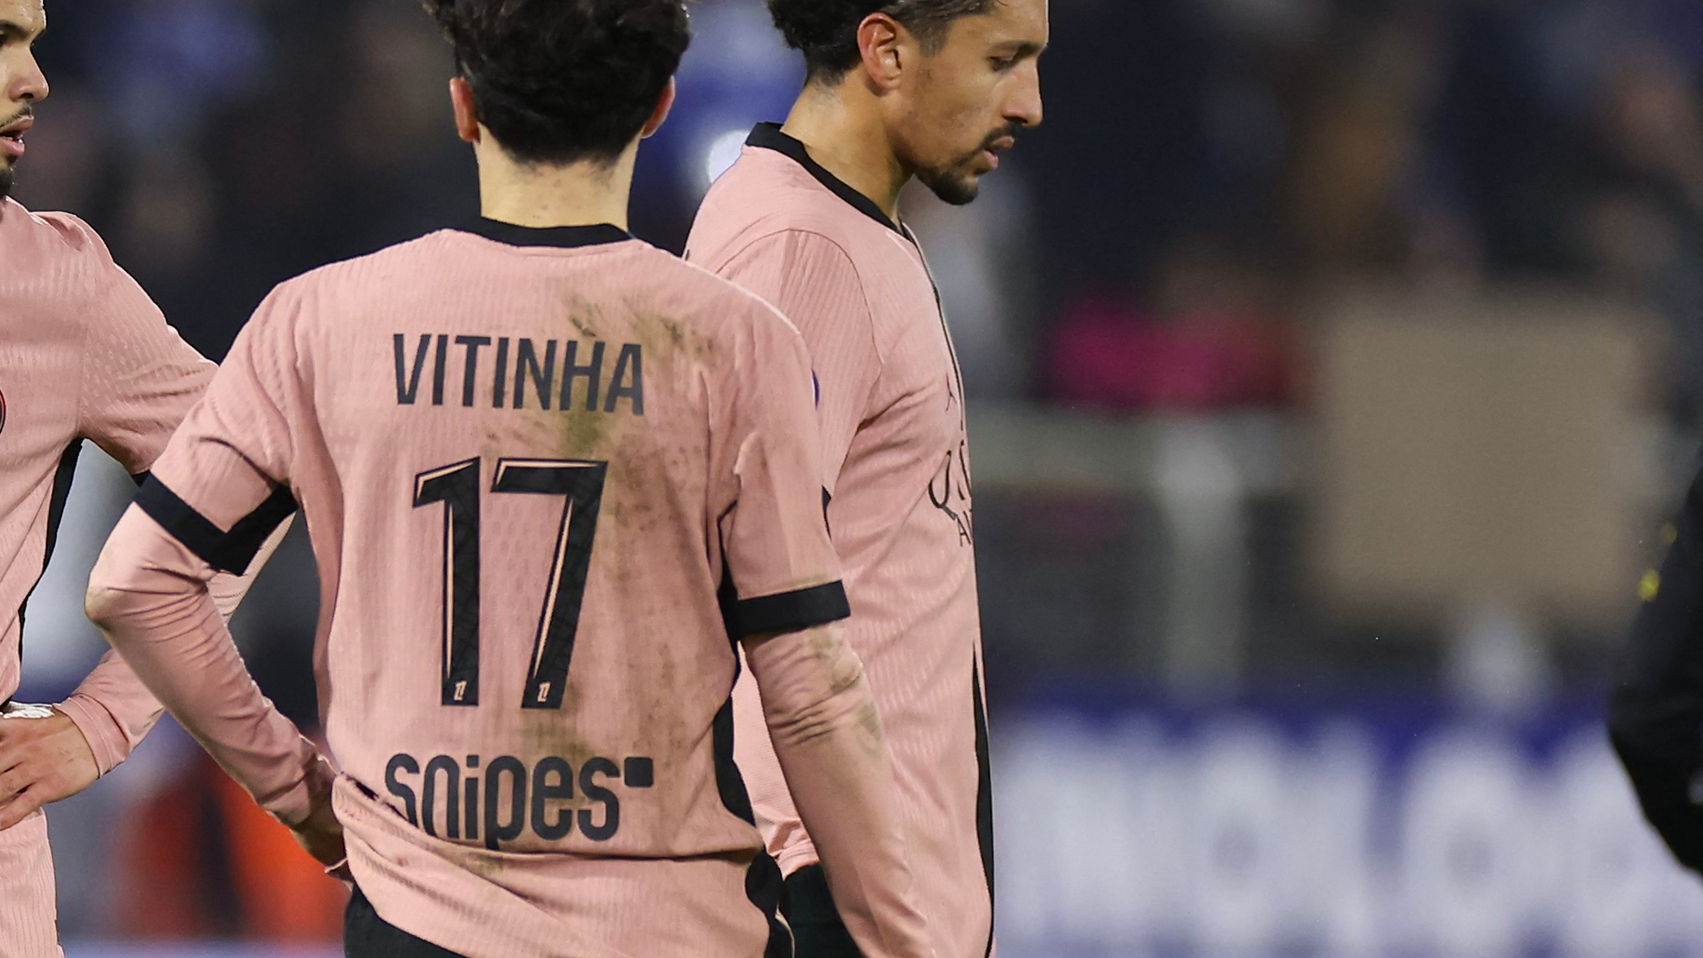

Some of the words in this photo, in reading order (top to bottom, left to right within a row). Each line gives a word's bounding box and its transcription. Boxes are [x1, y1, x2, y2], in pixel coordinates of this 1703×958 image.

[393, 333, 644, 416] VITINHA
[412, 456, 608, 709] 17
[385, 753, 620, 850] snipes
